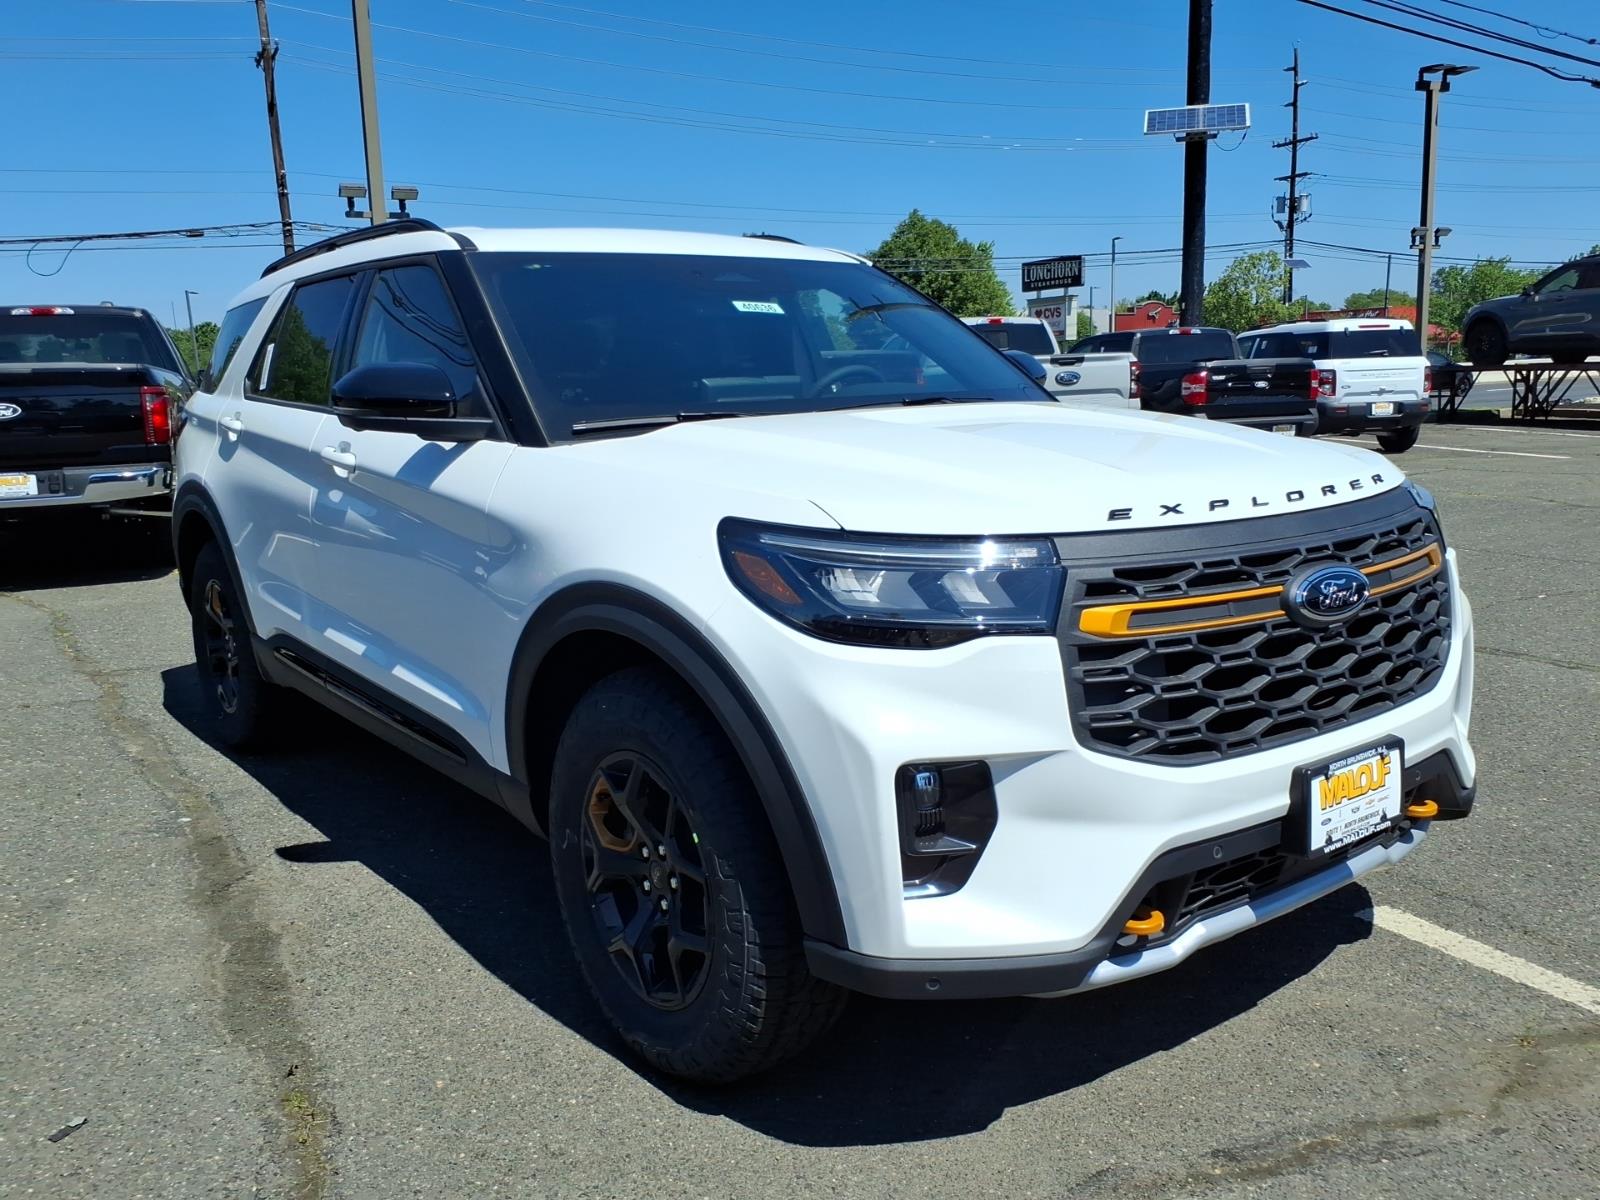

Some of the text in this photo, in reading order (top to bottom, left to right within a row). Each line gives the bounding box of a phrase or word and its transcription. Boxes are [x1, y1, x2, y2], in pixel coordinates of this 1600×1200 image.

[1024, 261, 1079, 281] LONGHORN
[1031, 278, 1072, 288] STEAKHOUSE
[1043, 307, 1061, 319] CVS
[1107, 474, 1384, 521] EXPLORER
[1319, 578, 1359, 610] Ford
[1329, 759, 1347, 770] NORTH
[1319, 755, 1391, 811] MALOUF
